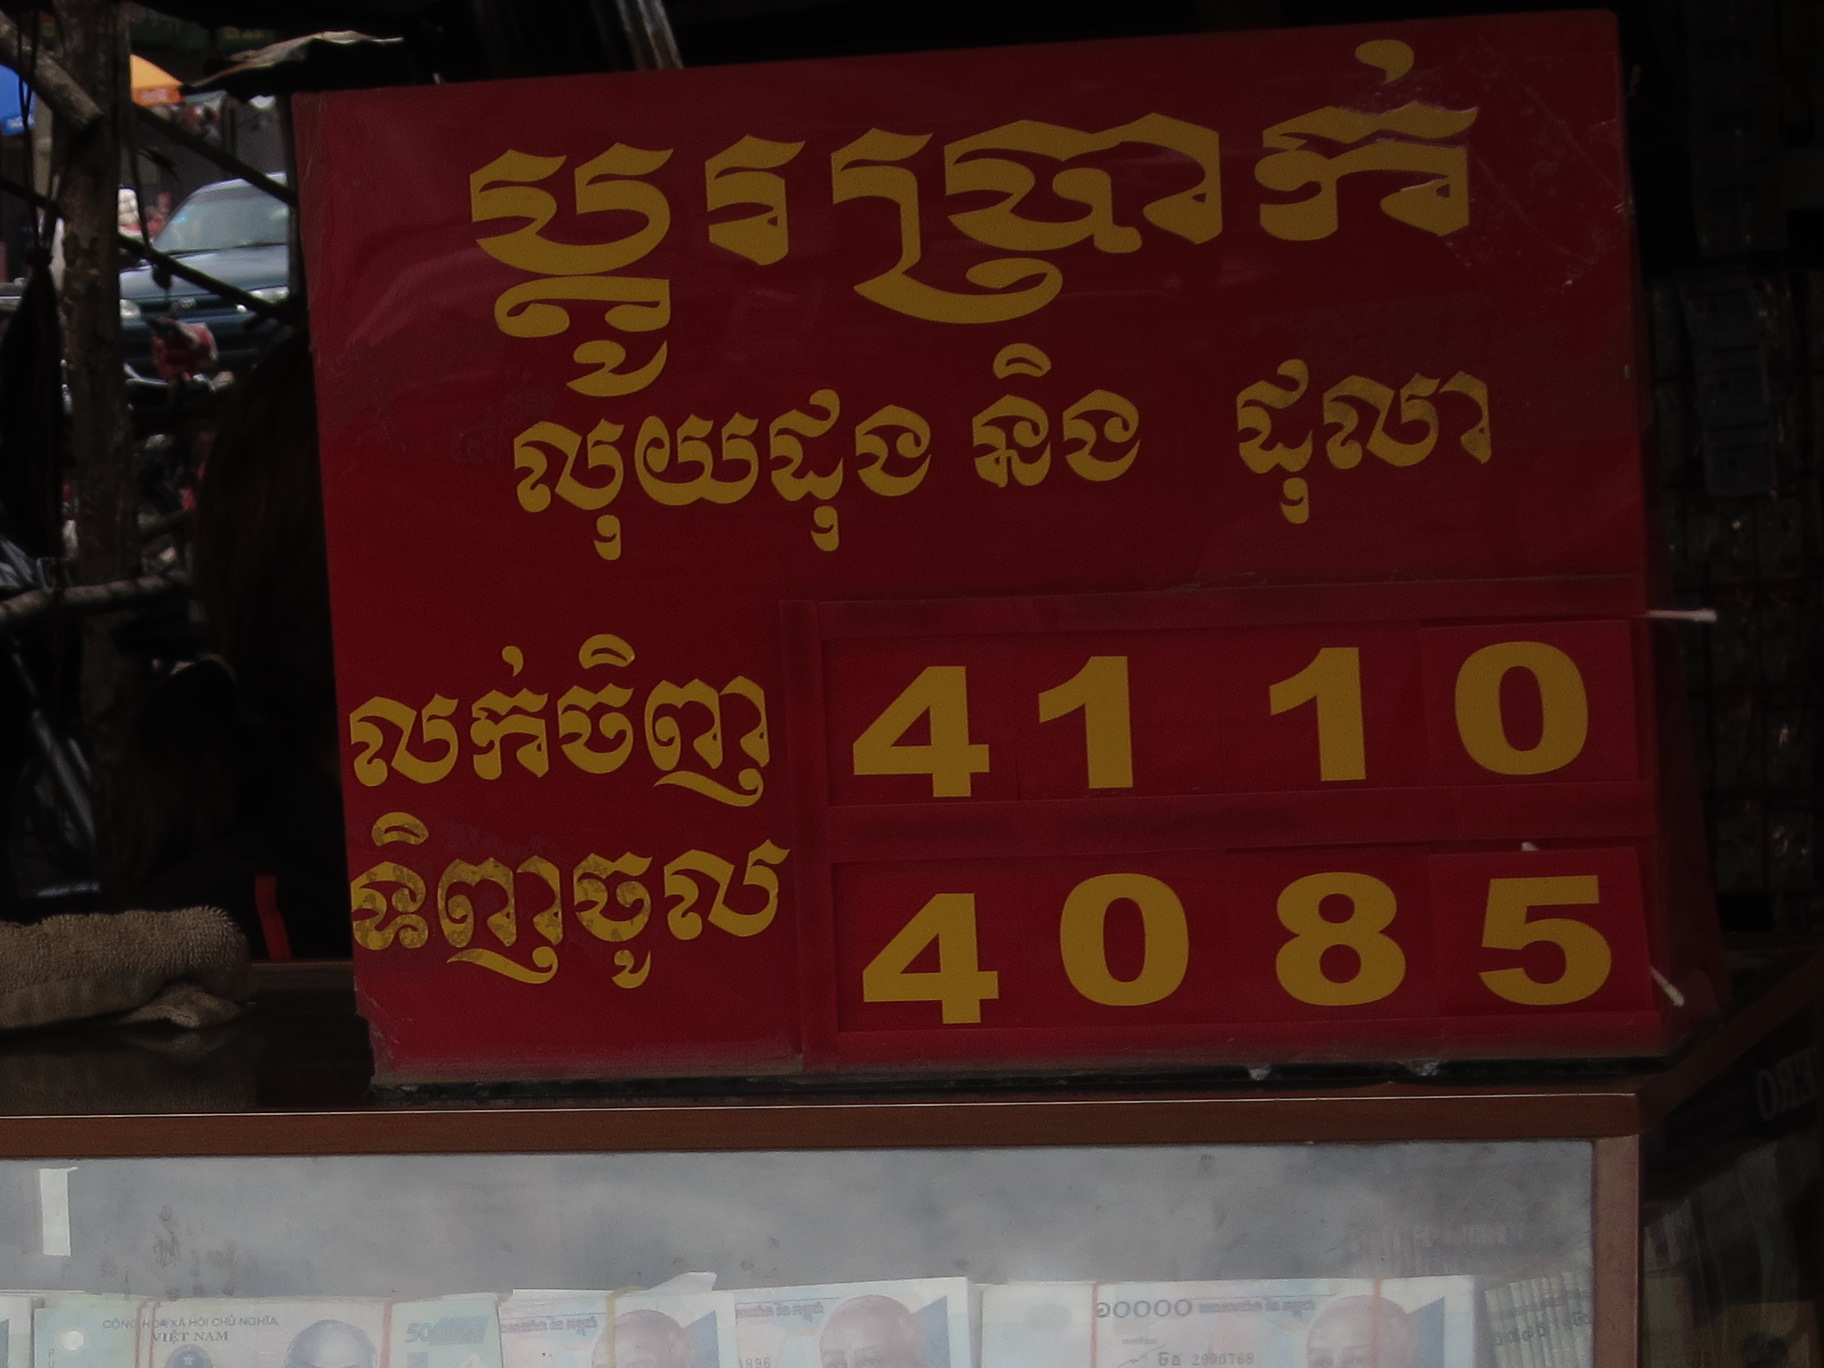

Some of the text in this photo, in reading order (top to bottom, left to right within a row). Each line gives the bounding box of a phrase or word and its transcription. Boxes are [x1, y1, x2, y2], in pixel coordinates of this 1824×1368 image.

[970, 342, 1142, 489] និង
[351, 813, 790, 989] ទិញចូល
[860, 871, 1612, 1024] 4085
[192, 1331, 229, 1343] NAM
